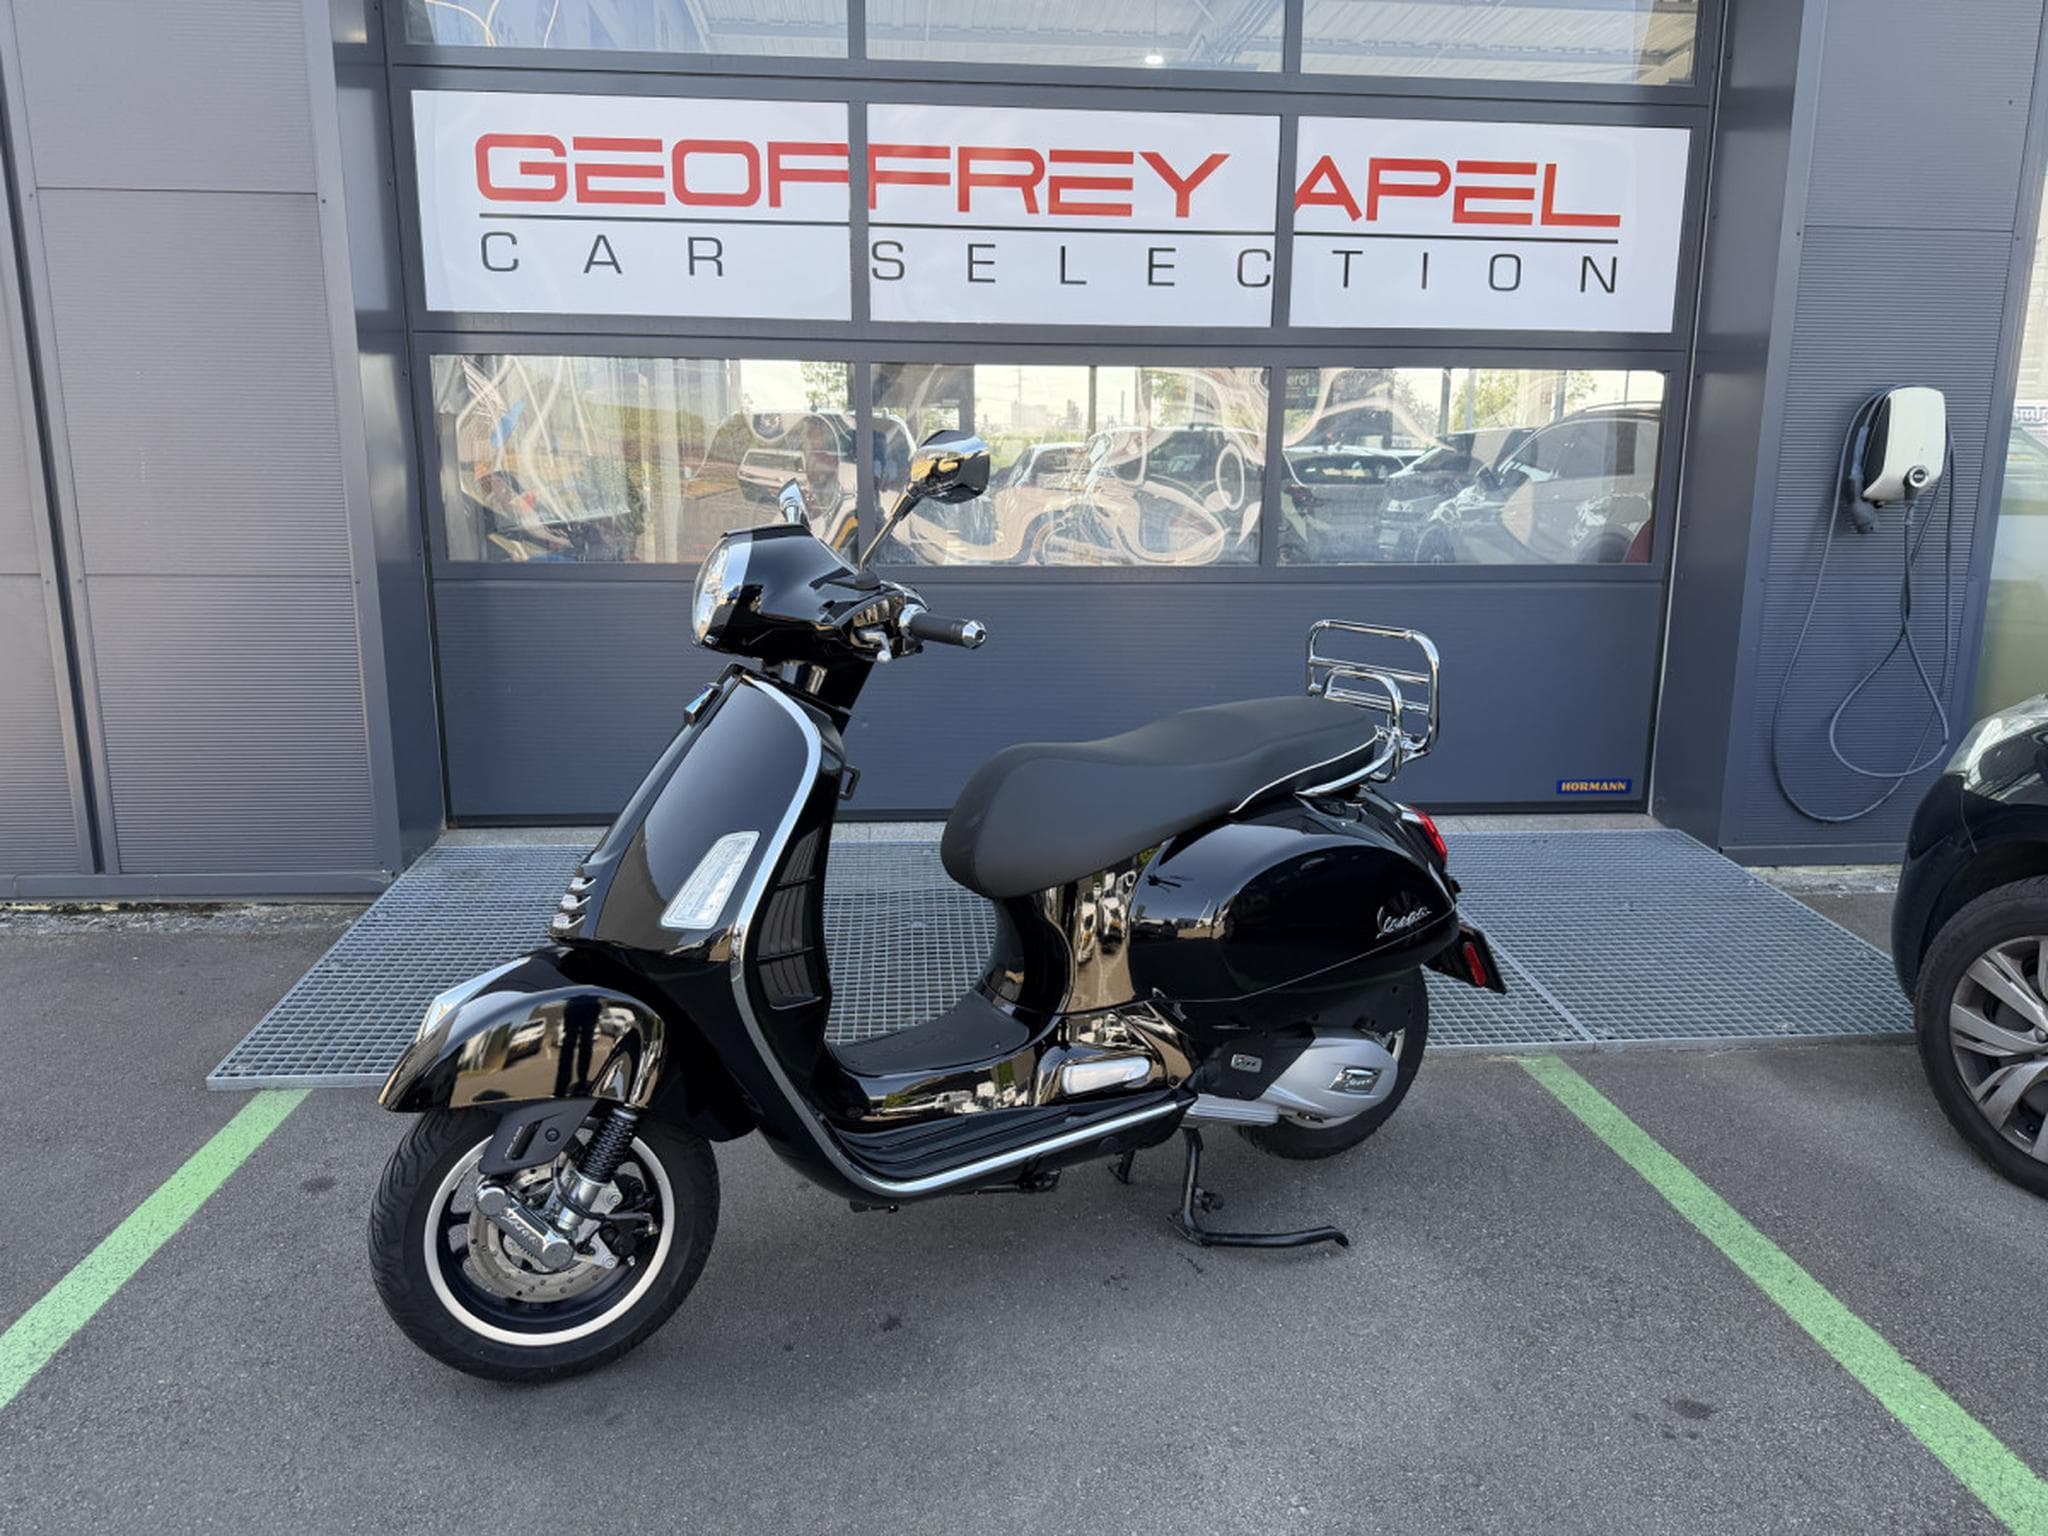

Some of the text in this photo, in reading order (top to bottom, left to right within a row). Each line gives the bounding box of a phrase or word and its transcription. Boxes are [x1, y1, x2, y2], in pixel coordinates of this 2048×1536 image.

[475, 132, 1621, 228] GEOFFREY APEL
[480, 231, 1618, 293] CAR SELECTION
